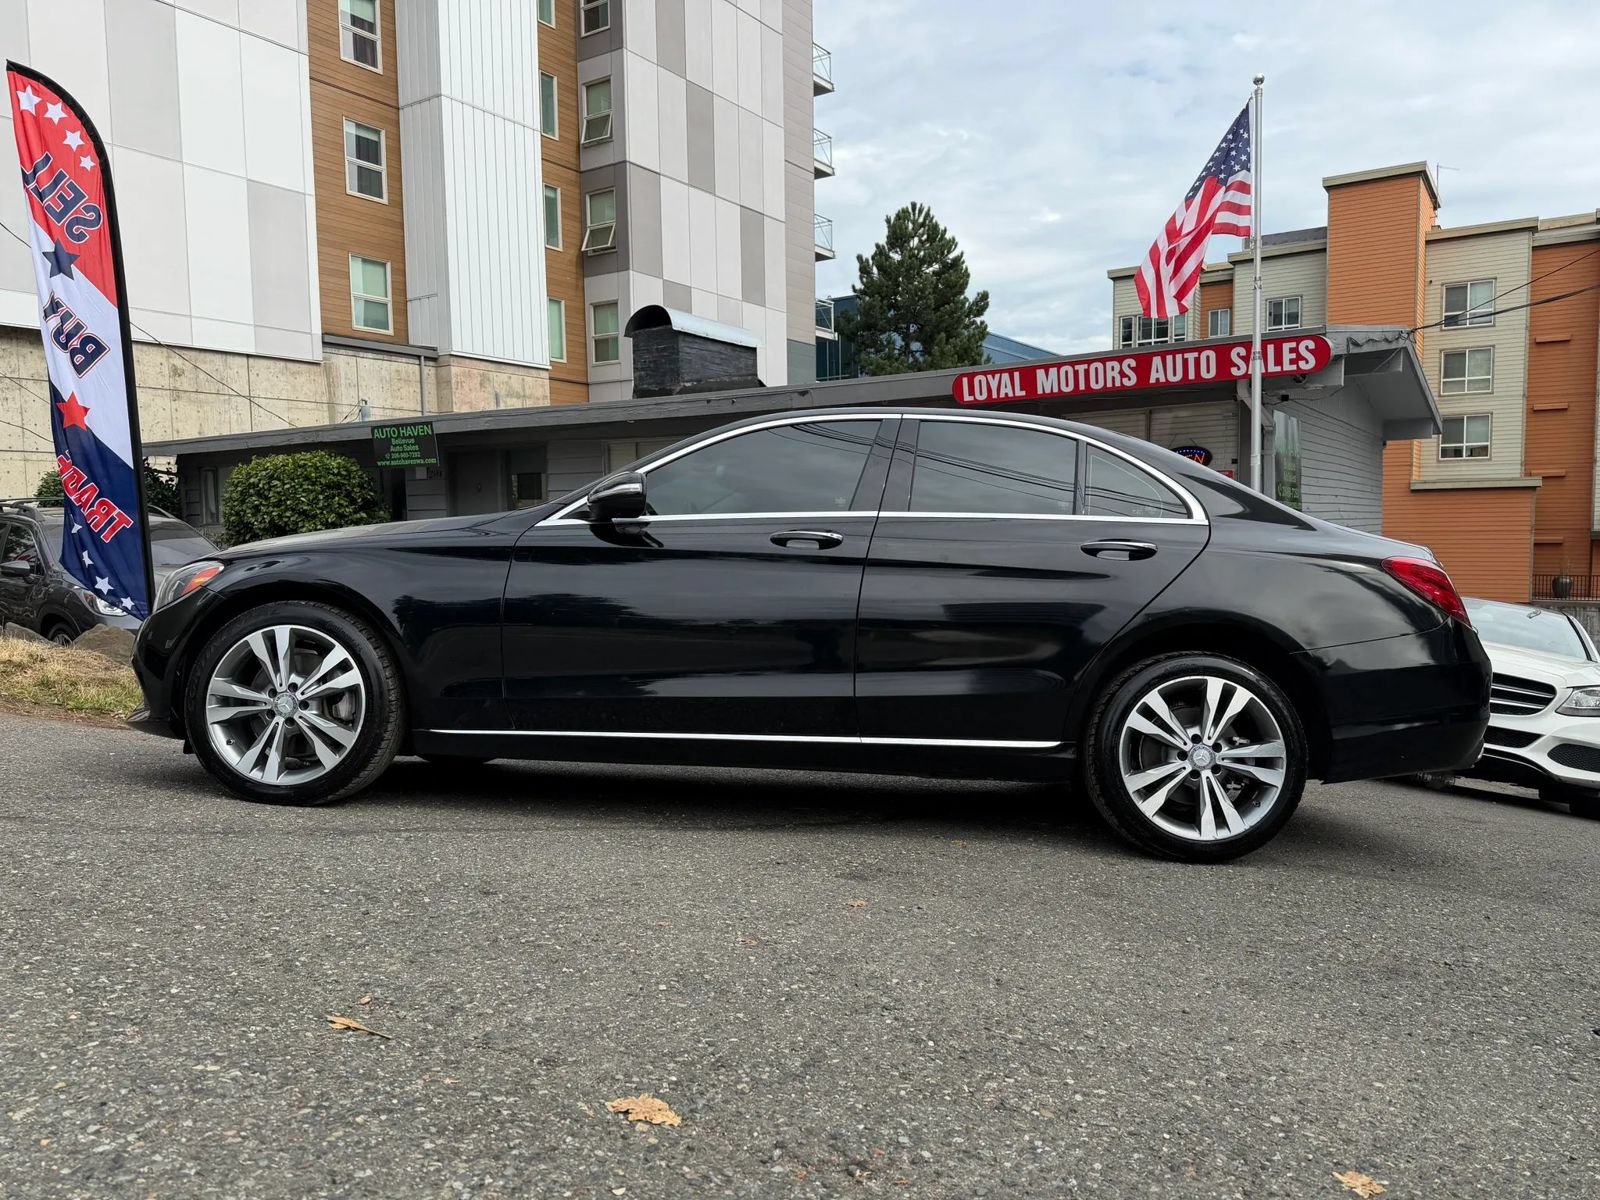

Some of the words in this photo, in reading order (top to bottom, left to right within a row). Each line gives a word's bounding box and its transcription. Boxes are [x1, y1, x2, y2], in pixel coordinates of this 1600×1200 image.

[962, 371, 1026, 402] LOYAL
[1036, 358, 1137, 395] MOTORS
[1149, 349, 1217, 384] AUTO
[374, 427, 398, 438] AUTO
[399, 425, 432, 436] HAVEN
